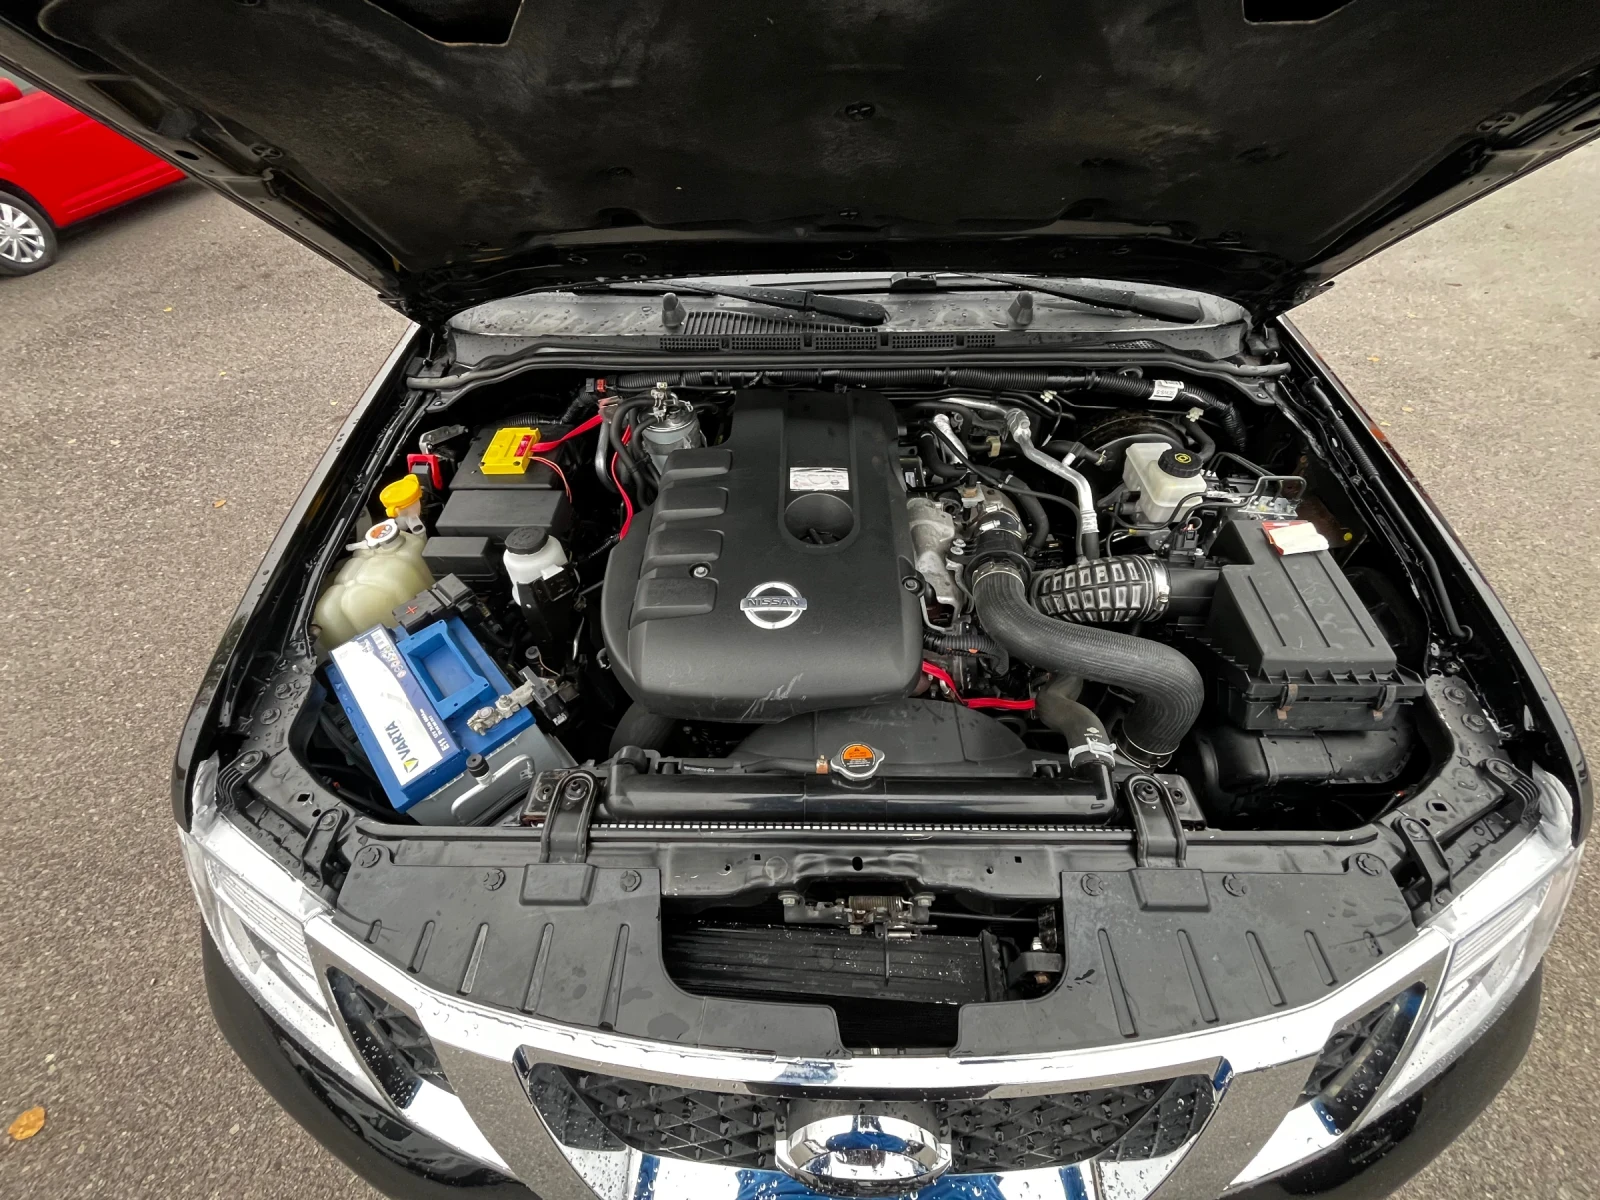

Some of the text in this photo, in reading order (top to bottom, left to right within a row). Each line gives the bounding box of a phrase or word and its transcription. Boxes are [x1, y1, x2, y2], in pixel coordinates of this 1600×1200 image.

[748, 598, 800, 606] NISSAN
[385, 721, 410, 760] VARTA
[438, 738, 450, 751] E11
